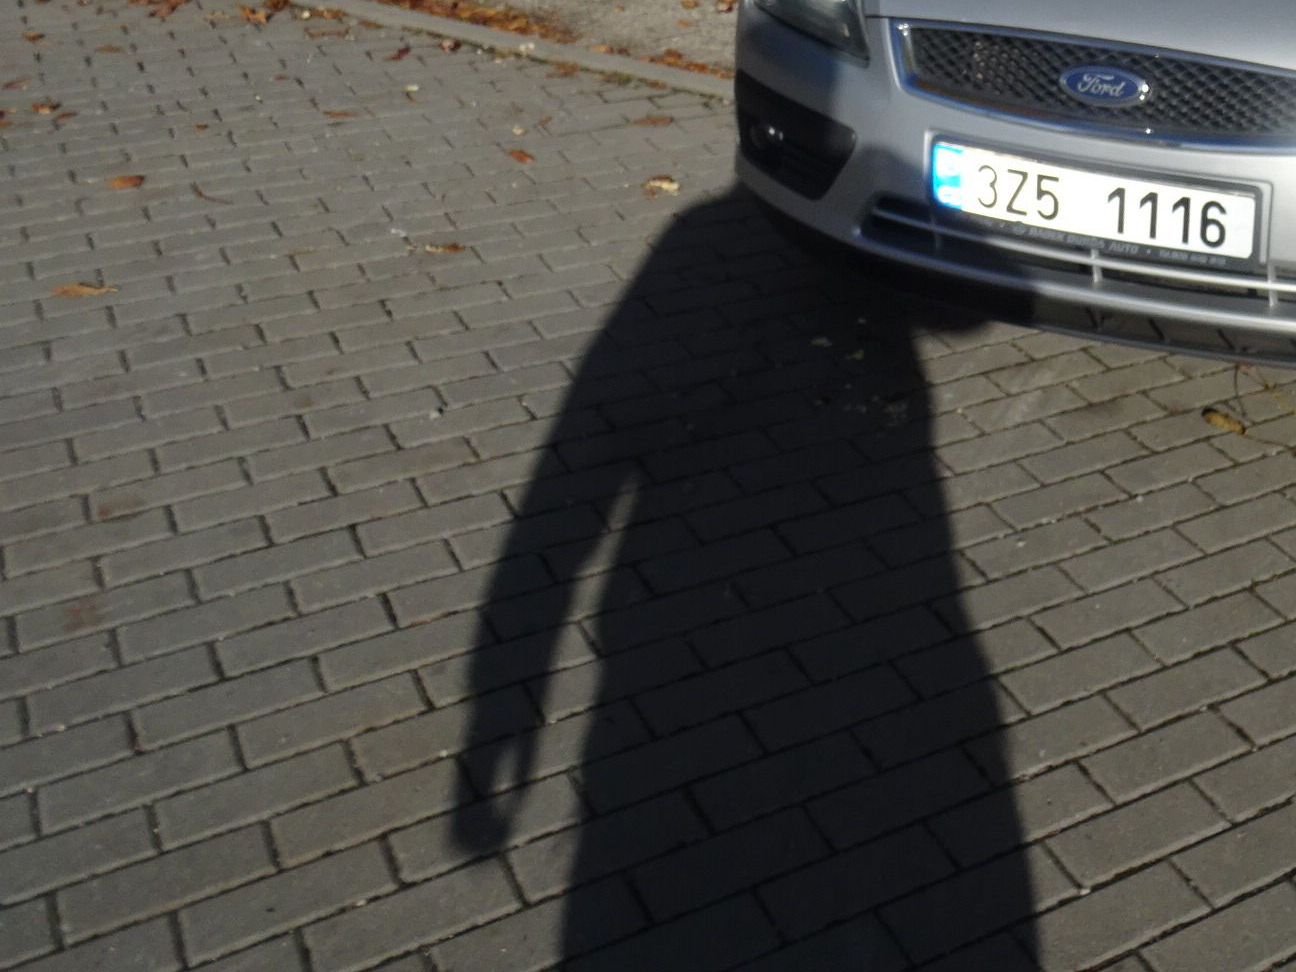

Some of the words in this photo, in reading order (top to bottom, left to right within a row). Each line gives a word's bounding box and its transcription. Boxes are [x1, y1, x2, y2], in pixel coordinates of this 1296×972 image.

[1078, 73, 1126, 97] Ford
[976, 164, 1060, 221] 3Z5
[1107, 187, 1227, 248] 1116
